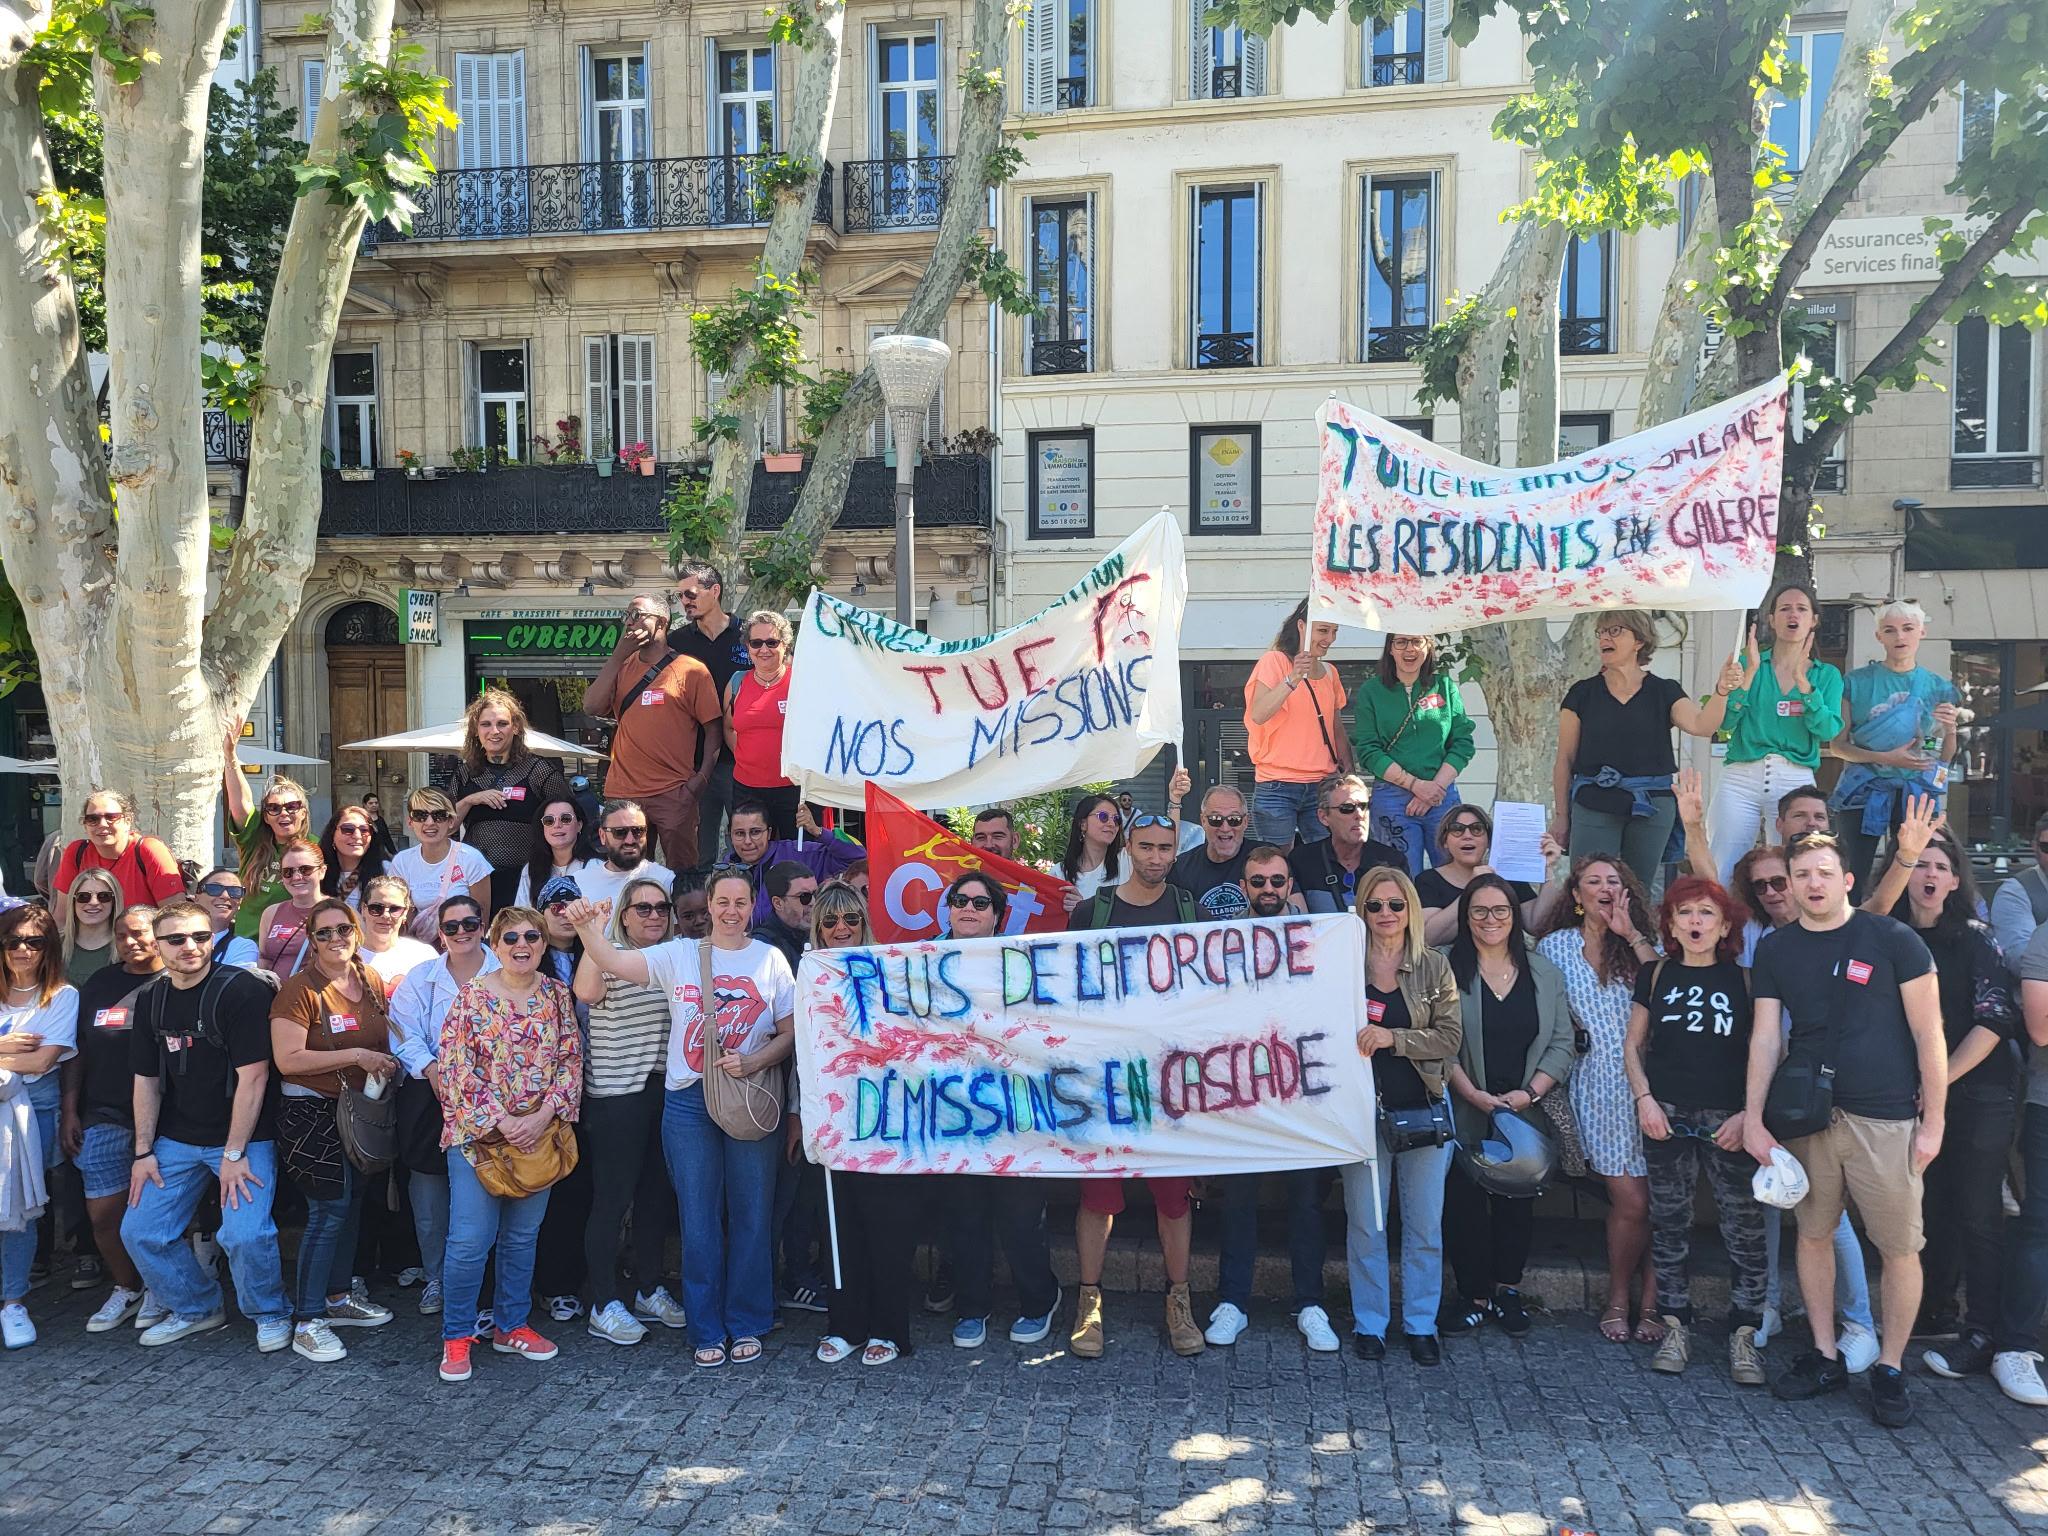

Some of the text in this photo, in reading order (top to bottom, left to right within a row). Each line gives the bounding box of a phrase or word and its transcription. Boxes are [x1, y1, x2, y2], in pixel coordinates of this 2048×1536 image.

[1824, 257, 1896, 274] Services
[1327, 521, 1383, 573] LES
[409, 593, 434, 606] CYBER
[412, 611, 432, 624] CAFE
[409, 628, 437, 642] SNACK
[903, 636, 1056, 715] TUE
[825, 654, 1153, 776] NOS MISSIONS
[845, 950, 972, 1030] PLUS
[1003, 943, 1058, 1006] DE
[1106, 1059, 1153, 1125] EN
[1161, 1031, 1332, 1120] CASCADE
